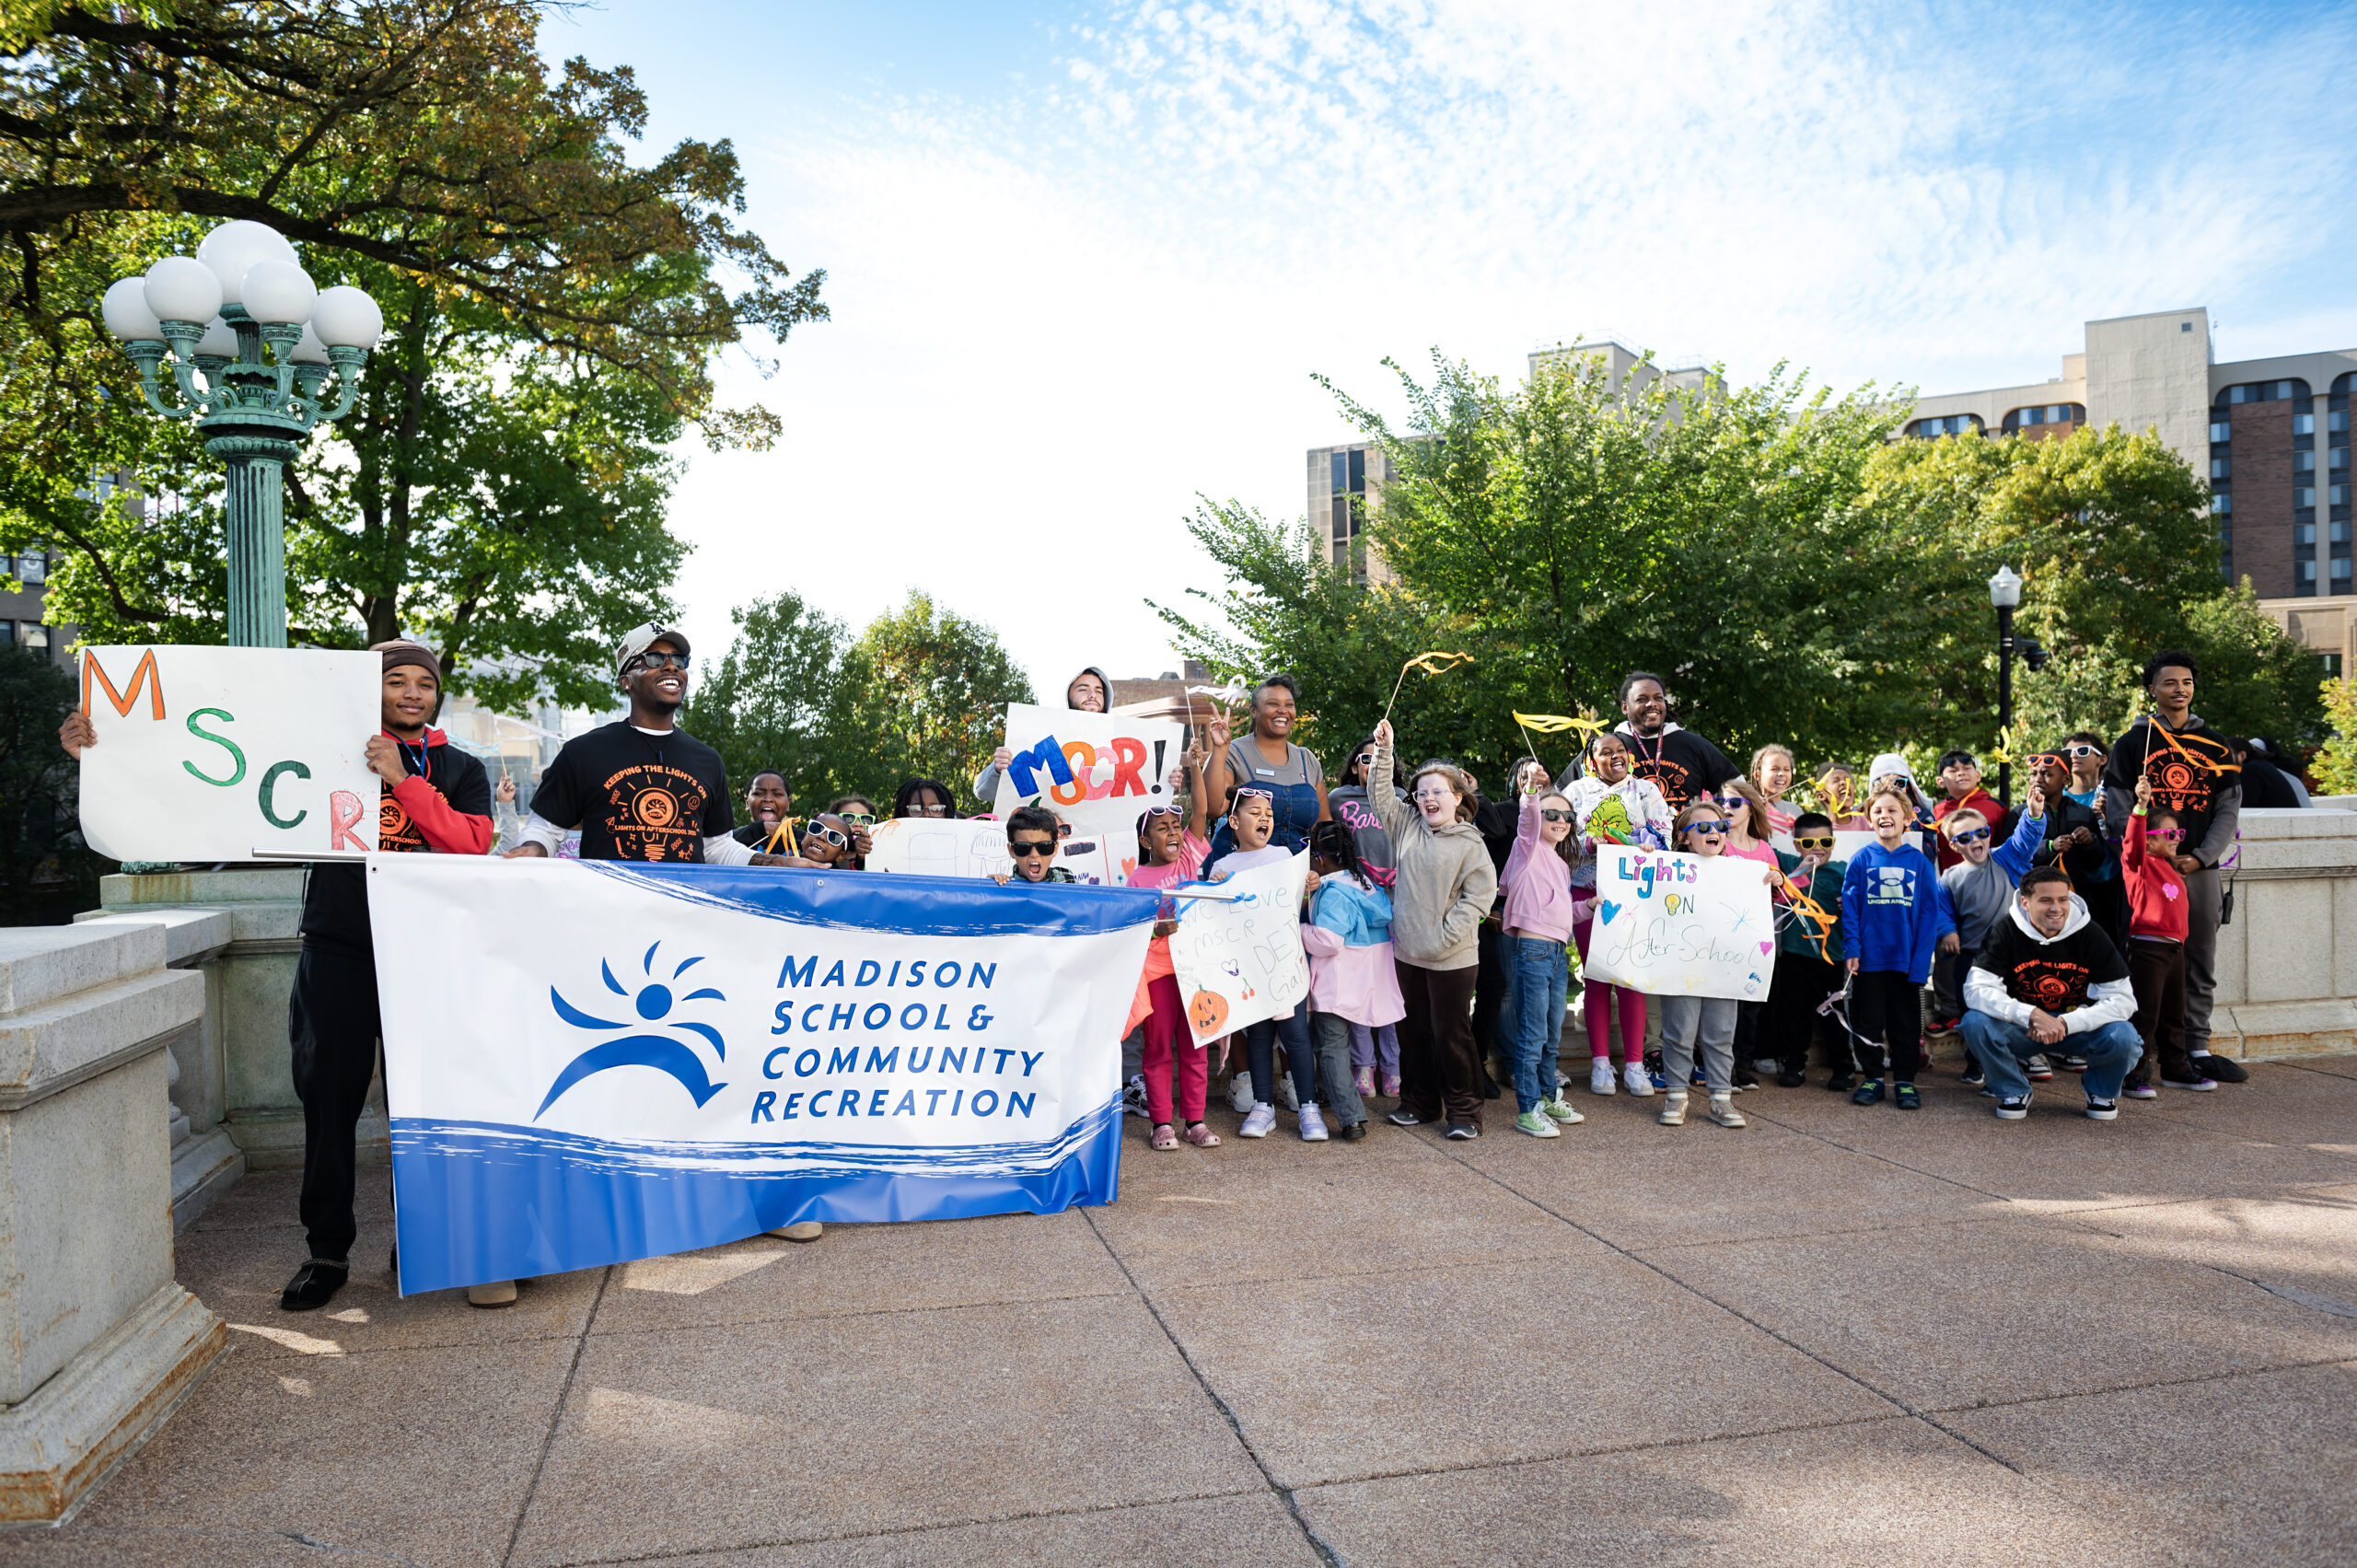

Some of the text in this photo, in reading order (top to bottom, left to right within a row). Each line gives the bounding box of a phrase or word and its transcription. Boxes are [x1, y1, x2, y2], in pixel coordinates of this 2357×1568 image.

[81, 647, 370, 852] MSCR
[603, 764, 707, 800] KEEPING THE LIGHTS ON
[646, 827, 687, 835] AFTERSCHOOL
[1619, 855, 1698, 899] Lights
[967, 1004, 994, 1031] &
